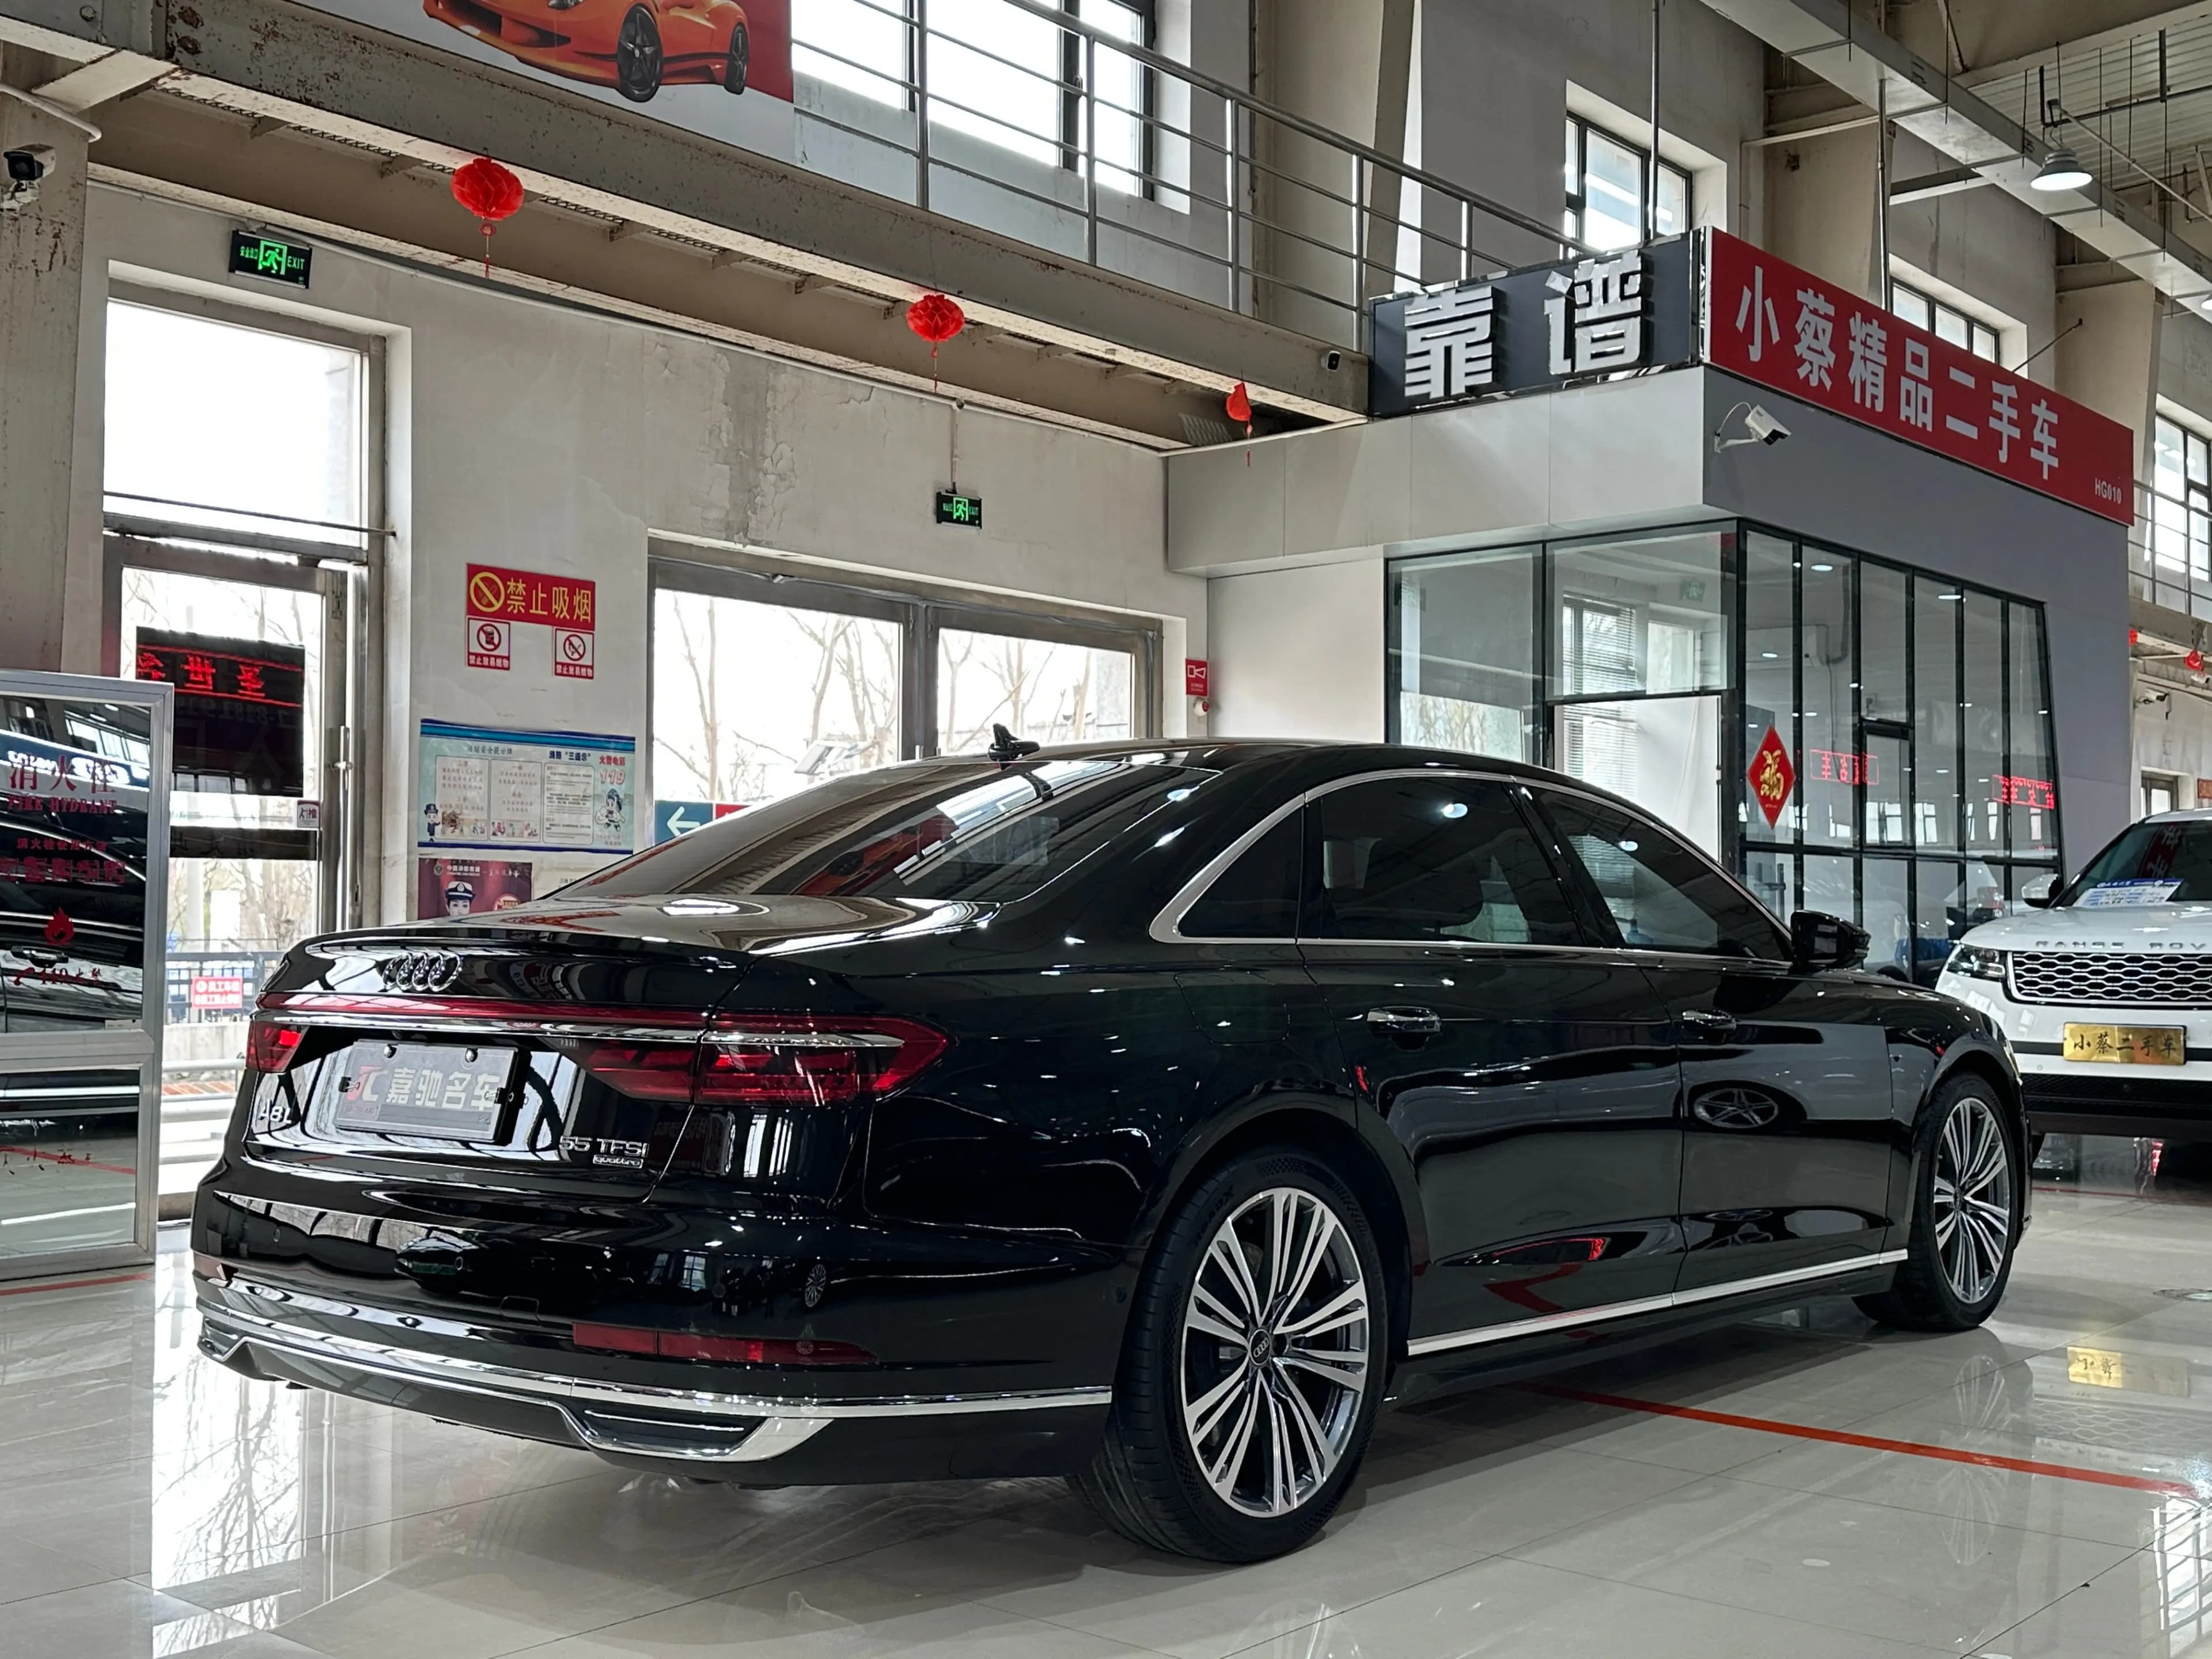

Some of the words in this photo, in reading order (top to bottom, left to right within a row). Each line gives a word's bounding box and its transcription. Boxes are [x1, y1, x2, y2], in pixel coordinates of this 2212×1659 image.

[287, 256, 305, 270] EXIT
[1404, 250, 1642, 399] 靠谱
[1736, 266, 2059, 480] 小蔡精品二手车
[2094, 478, 2122, 504] HG010
[506, 577, 592, 623] 禁止吸烟
[10, 755, 116, 793] 消火栓
[600, 769, 626, 784] 119
[8, 795, 43, 810] FIRE
[2035, 941, 2124, 949] RANGE
[40, 968, 68, 984] 119
[2073, 1031, 2177, 1059] 小蔡二手车
[385, 1067, 500, 1111] 嘉驰名车
[559, 1135, 593, 1152] 55
[597, 1138, 649, 1157] TFSI
[594, 1156, 642, 1168] quattro
